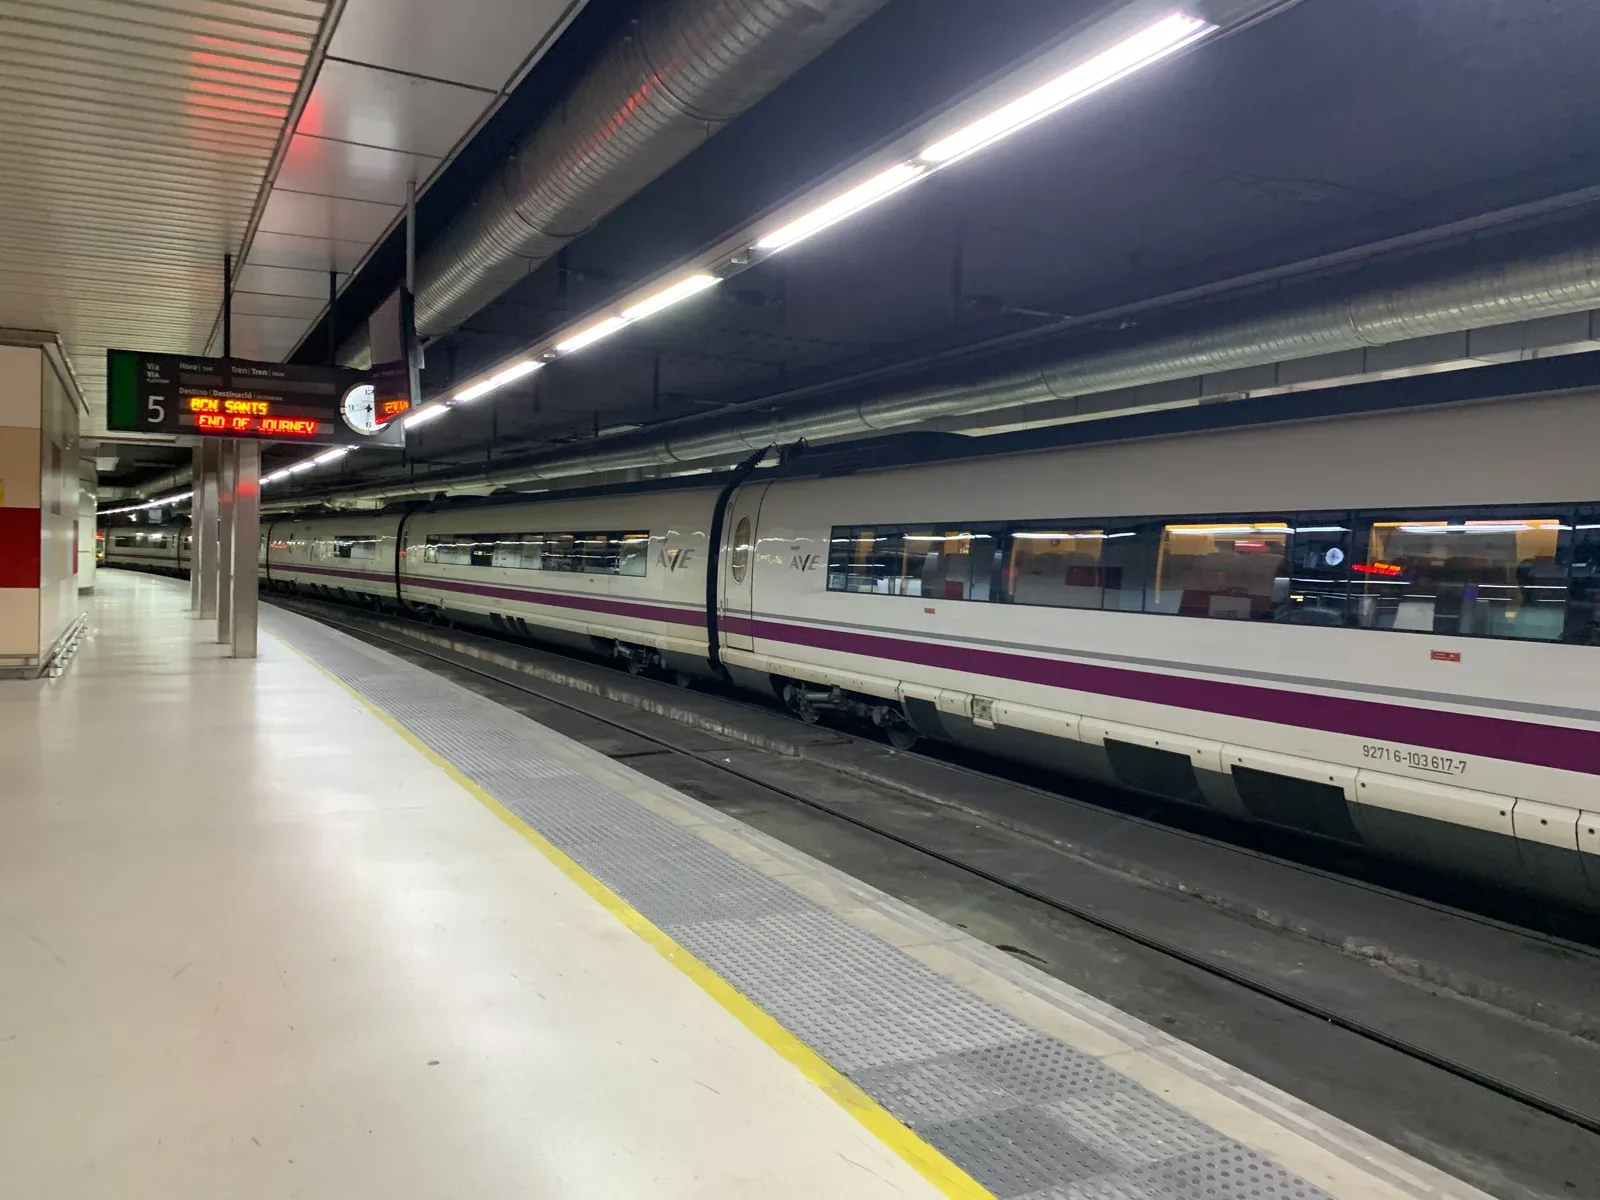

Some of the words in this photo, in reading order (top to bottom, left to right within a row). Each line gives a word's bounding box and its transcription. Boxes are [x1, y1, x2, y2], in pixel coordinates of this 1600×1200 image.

[179, 363, 197, 371] Hora
[231, 366, 247, 374] Tren
[252, 368, 268, 376] Tren
[179, 387, 208, 396] Destino
[213, 389, 252, 399] Destinació
[147, 395, 165, 423] 5
[191, 398, 219, 412] BCN
[225, 400, 268, 415] SANTS
[199, 415, 226, 428] END
[232, 417, 250, 430] OF
[257, 419, 314, 433] JOURNEY
[656, 548, 695, 573] AVE
[789, 554, 821, 572] AVE
[1362, 745, 1390, 760] 9271
[1394, 750, 1428, 767] 6-103
[1431, 756, 1467, 773] 617-7
